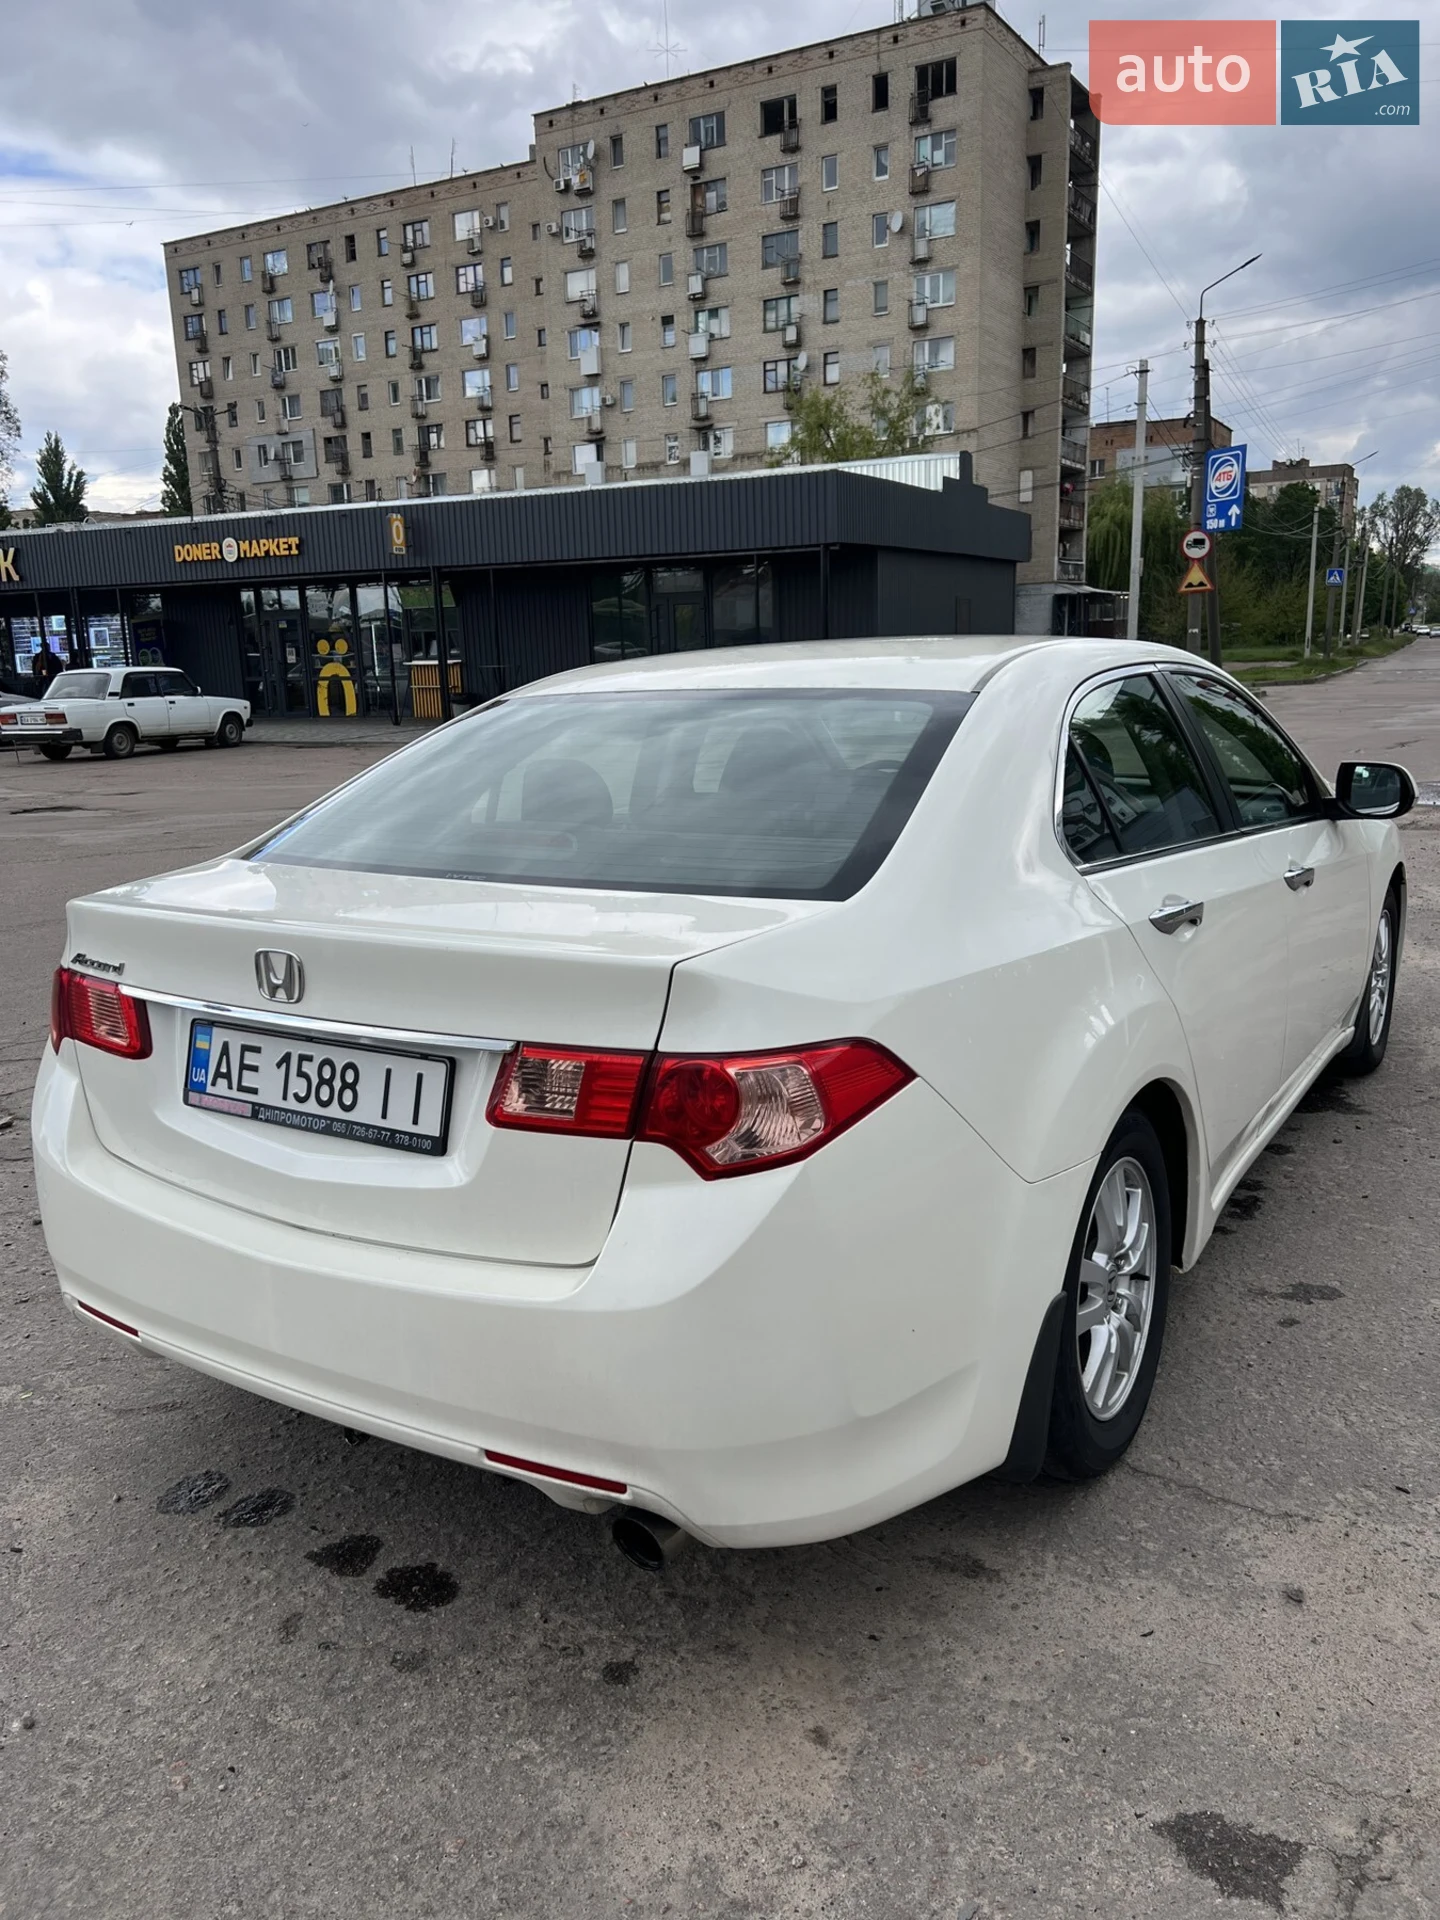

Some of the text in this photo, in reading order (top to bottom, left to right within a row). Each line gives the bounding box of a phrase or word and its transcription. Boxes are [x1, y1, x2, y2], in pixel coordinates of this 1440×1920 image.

[1215, 471, 1233, 482] АТБ
[1206, 519, 1218, 529] 150
[174, 537, 299, 562] DONER МАРКЕТ
[71, 953, 125, 976] Accord
[192, 1066, 206, 1083] UA
[210, 1040, 262, 1095] AE
[275, 1051, 360, 1112] 1588
[394, 1134, 432, 1150] 378-0100
